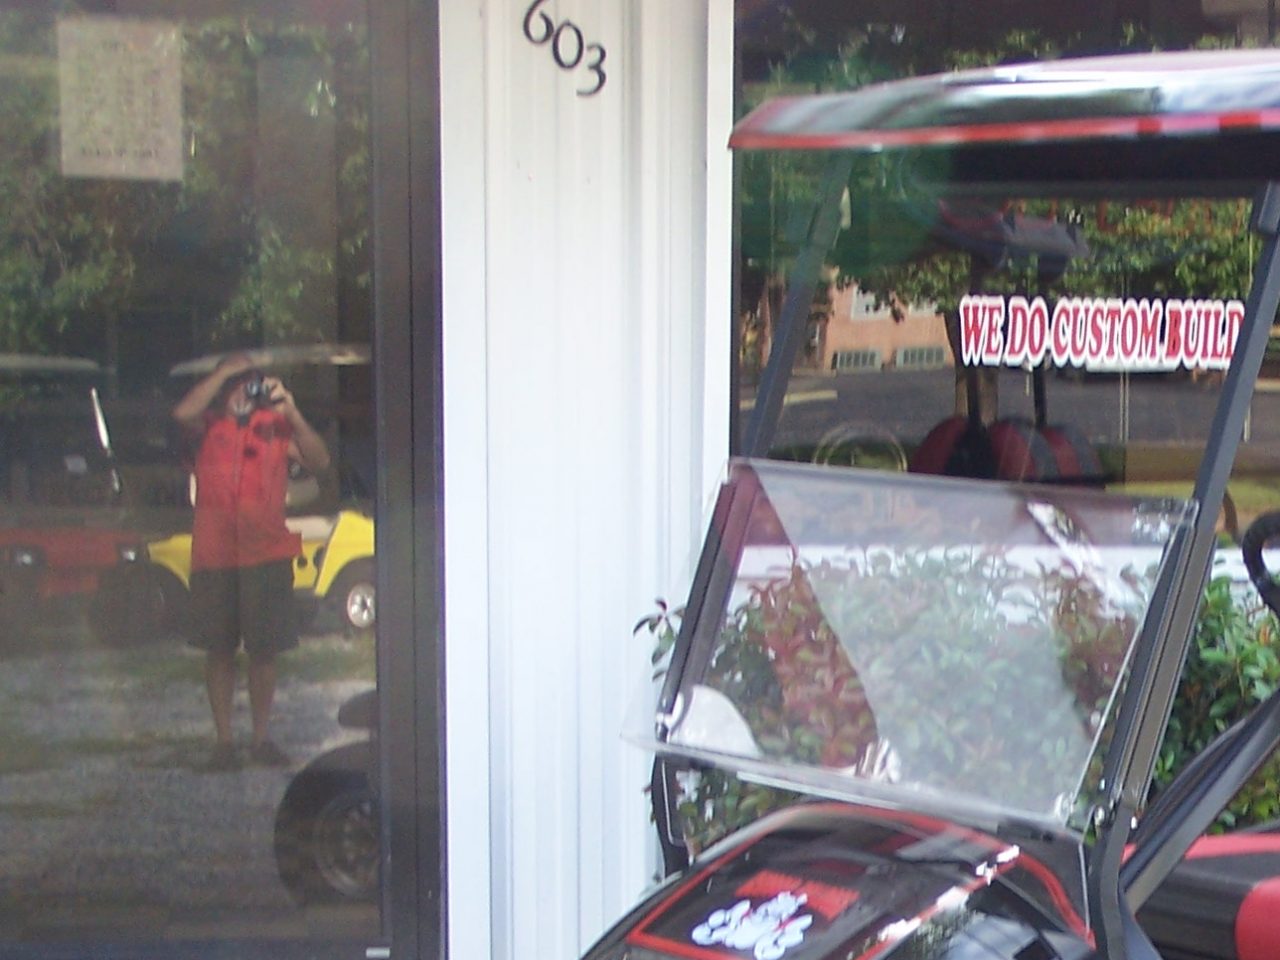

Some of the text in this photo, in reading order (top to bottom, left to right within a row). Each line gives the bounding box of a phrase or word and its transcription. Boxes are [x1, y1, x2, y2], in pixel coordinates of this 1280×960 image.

[523, 0, 606, 97] 603
[960, 297, 1003, 364] WE
[1003, 297, 1047, 365] DO
[1052, 298, 1163, 367] CUSTOM
